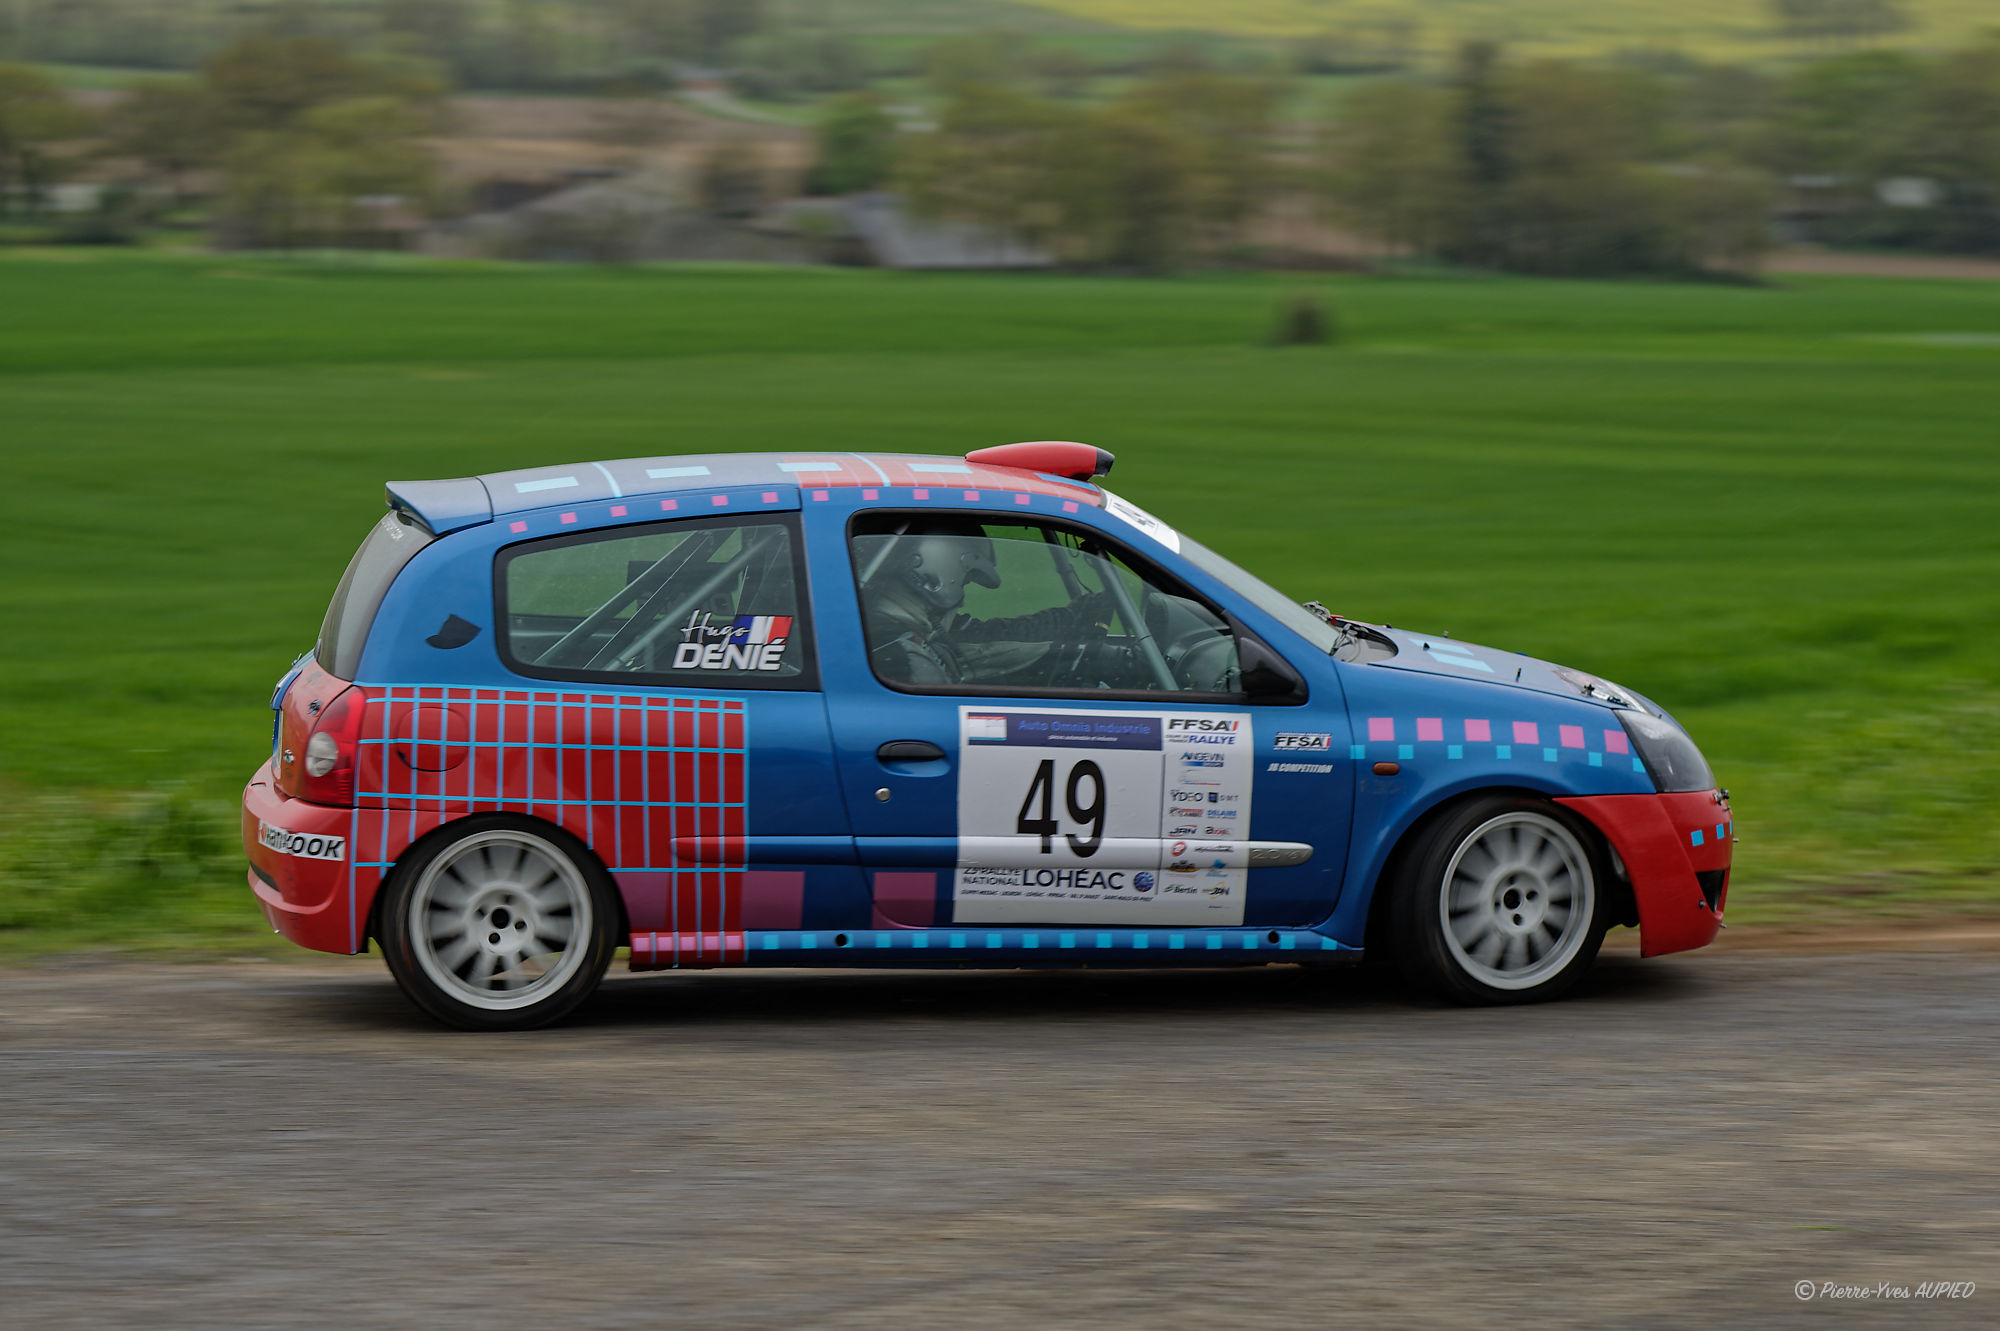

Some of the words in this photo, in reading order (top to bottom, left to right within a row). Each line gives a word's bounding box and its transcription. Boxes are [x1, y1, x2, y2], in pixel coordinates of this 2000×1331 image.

[680, 609, 751, 652] Hugo
[672, 638, 786, 671] DENIÉ
[1018, 720, 1048, 731] Auto
[1050, 721, 1091, 733] Omnia
[1094, 722, 1151, 734] Industrie
[1168, 719, 1230, 732] FFSA
[1188, 735, 1235, 745] RALLYE
[1274, 736, 1323, 747] FFSA
[1279, 763, 1334, 774] COMPETITION
[1016, 759, 1107, 859] 49
[963, 876, 1021, 886] NATIONAL
[1022, 868, 1125, 890] LOHÉAC
